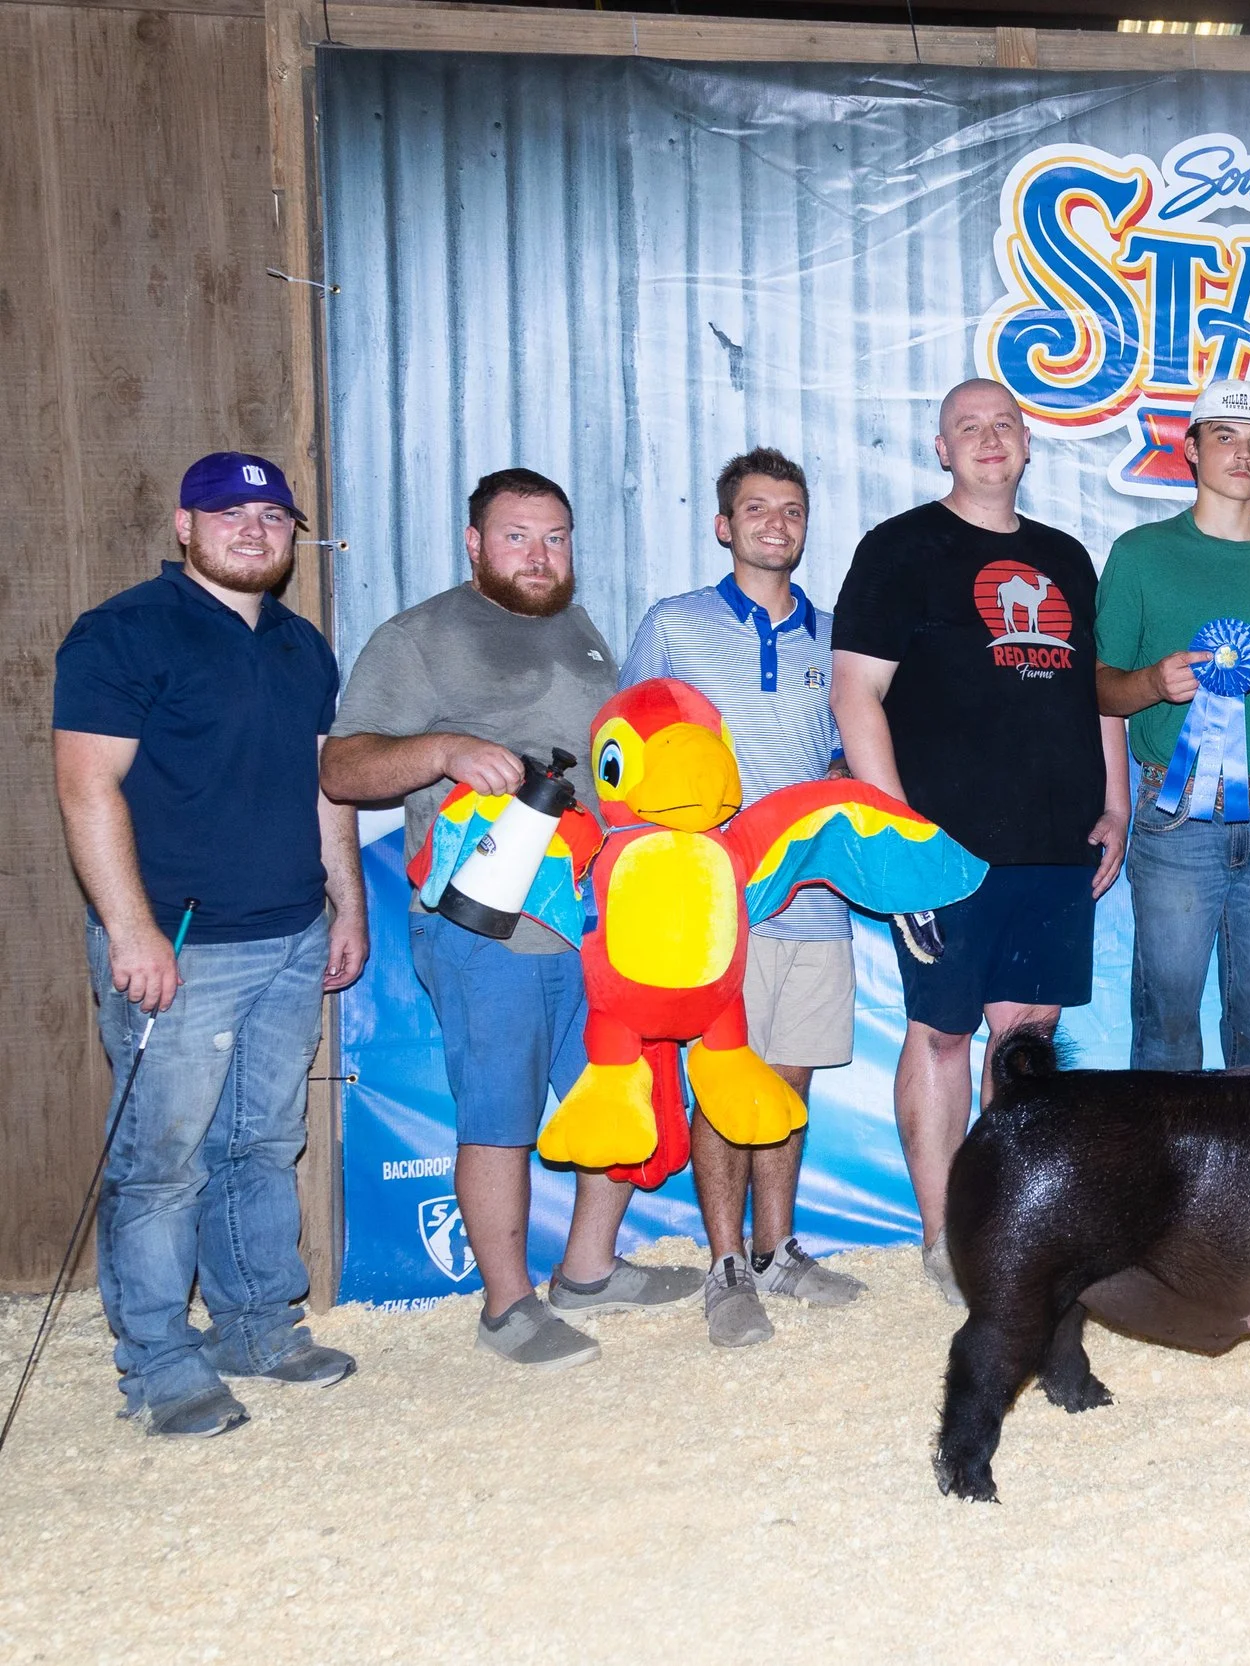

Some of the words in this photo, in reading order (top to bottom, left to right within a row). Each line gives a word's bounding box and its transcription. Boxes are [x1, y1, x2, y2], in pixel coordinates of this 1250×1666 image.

[1222, 393, 1248, 405] MILLER
[993, 646, 1026, 667] RED
[1027, 647, 1073, 670] ROCK
[1016, 662, 1055, 681] Farms
[383, 1156, 452, 1181] BACKDROP
